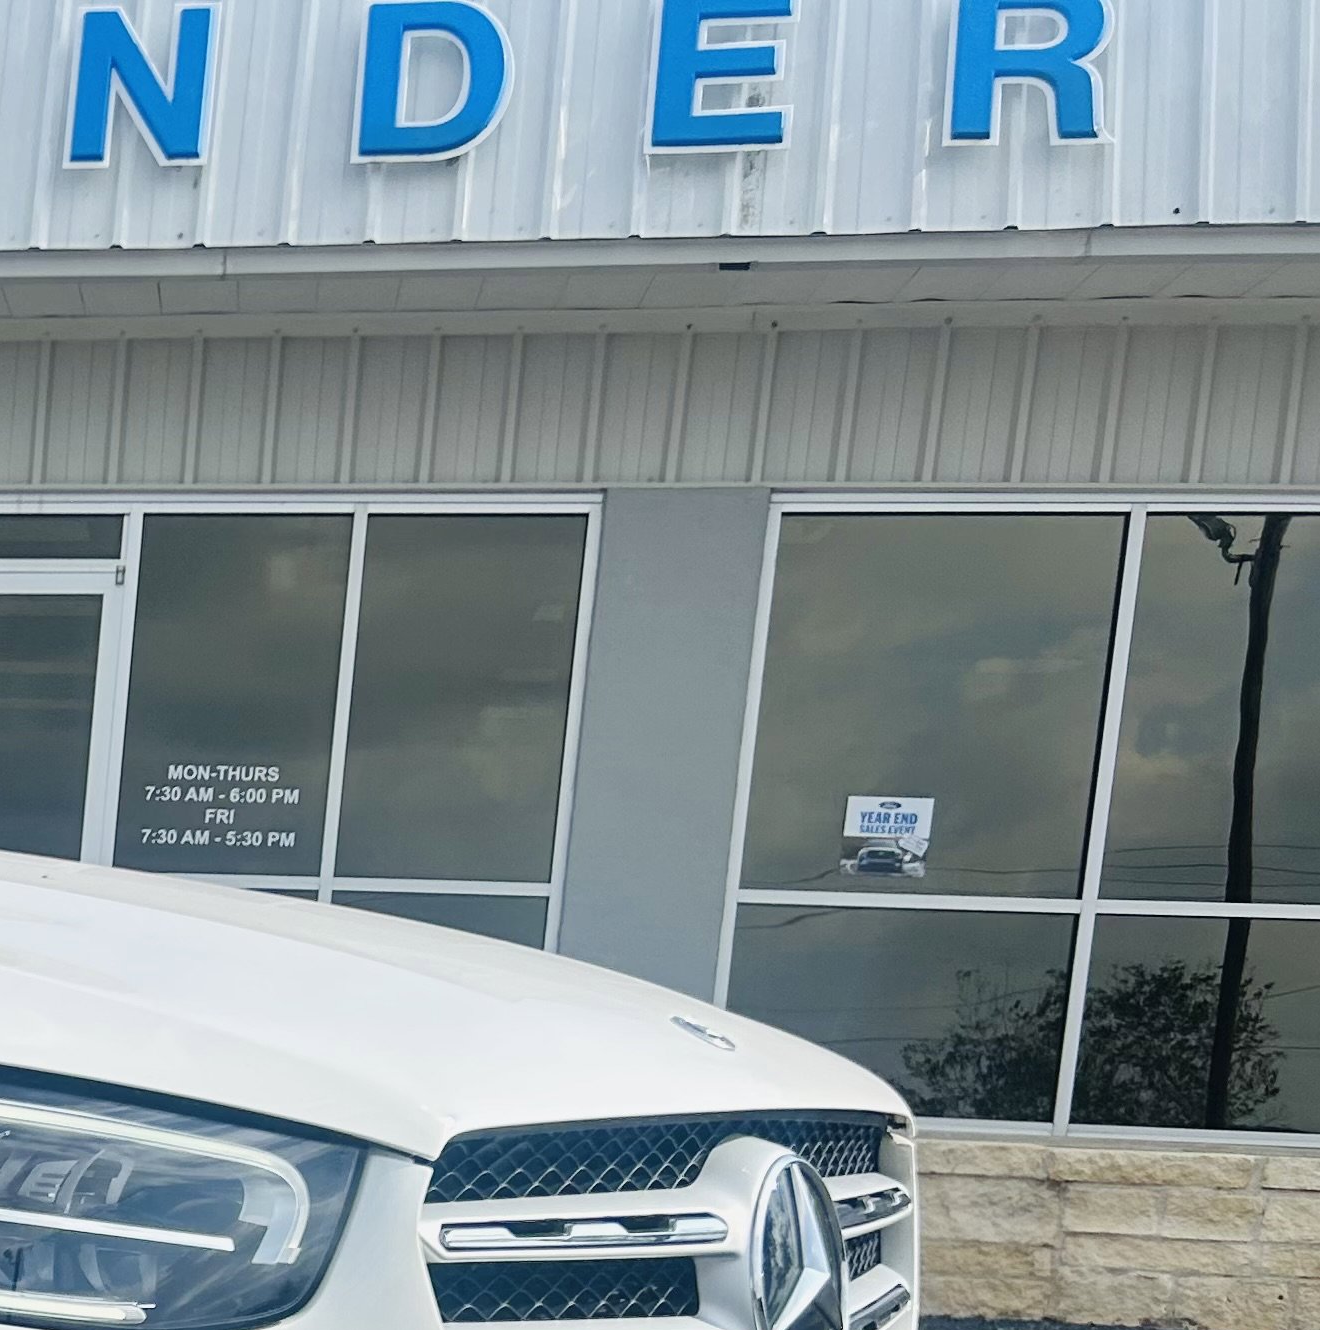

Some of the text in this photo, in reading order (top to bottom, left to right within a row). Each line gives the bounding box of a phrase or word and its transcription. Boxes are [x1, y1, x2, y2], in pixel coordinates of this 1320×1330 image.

[167, 764, 280, 782] MON-THURS
[144, 785, 182, 801] 7:30
[184, 786, 214, 802] AM
[229, 787, 266, 804] 6:00
[271, 788, 300, 805] PM
[204, 808, 235, 824] FRI
[860, 811, 918, 825] YEAR END
[141, 828, 177, 844] 7:30
[180, 829, 210, 845] AM
[225, 830, 263, 846] 5:30
[267, 831, 296, 848] PM
[859, 825, 916, 835] SALES EVENT
